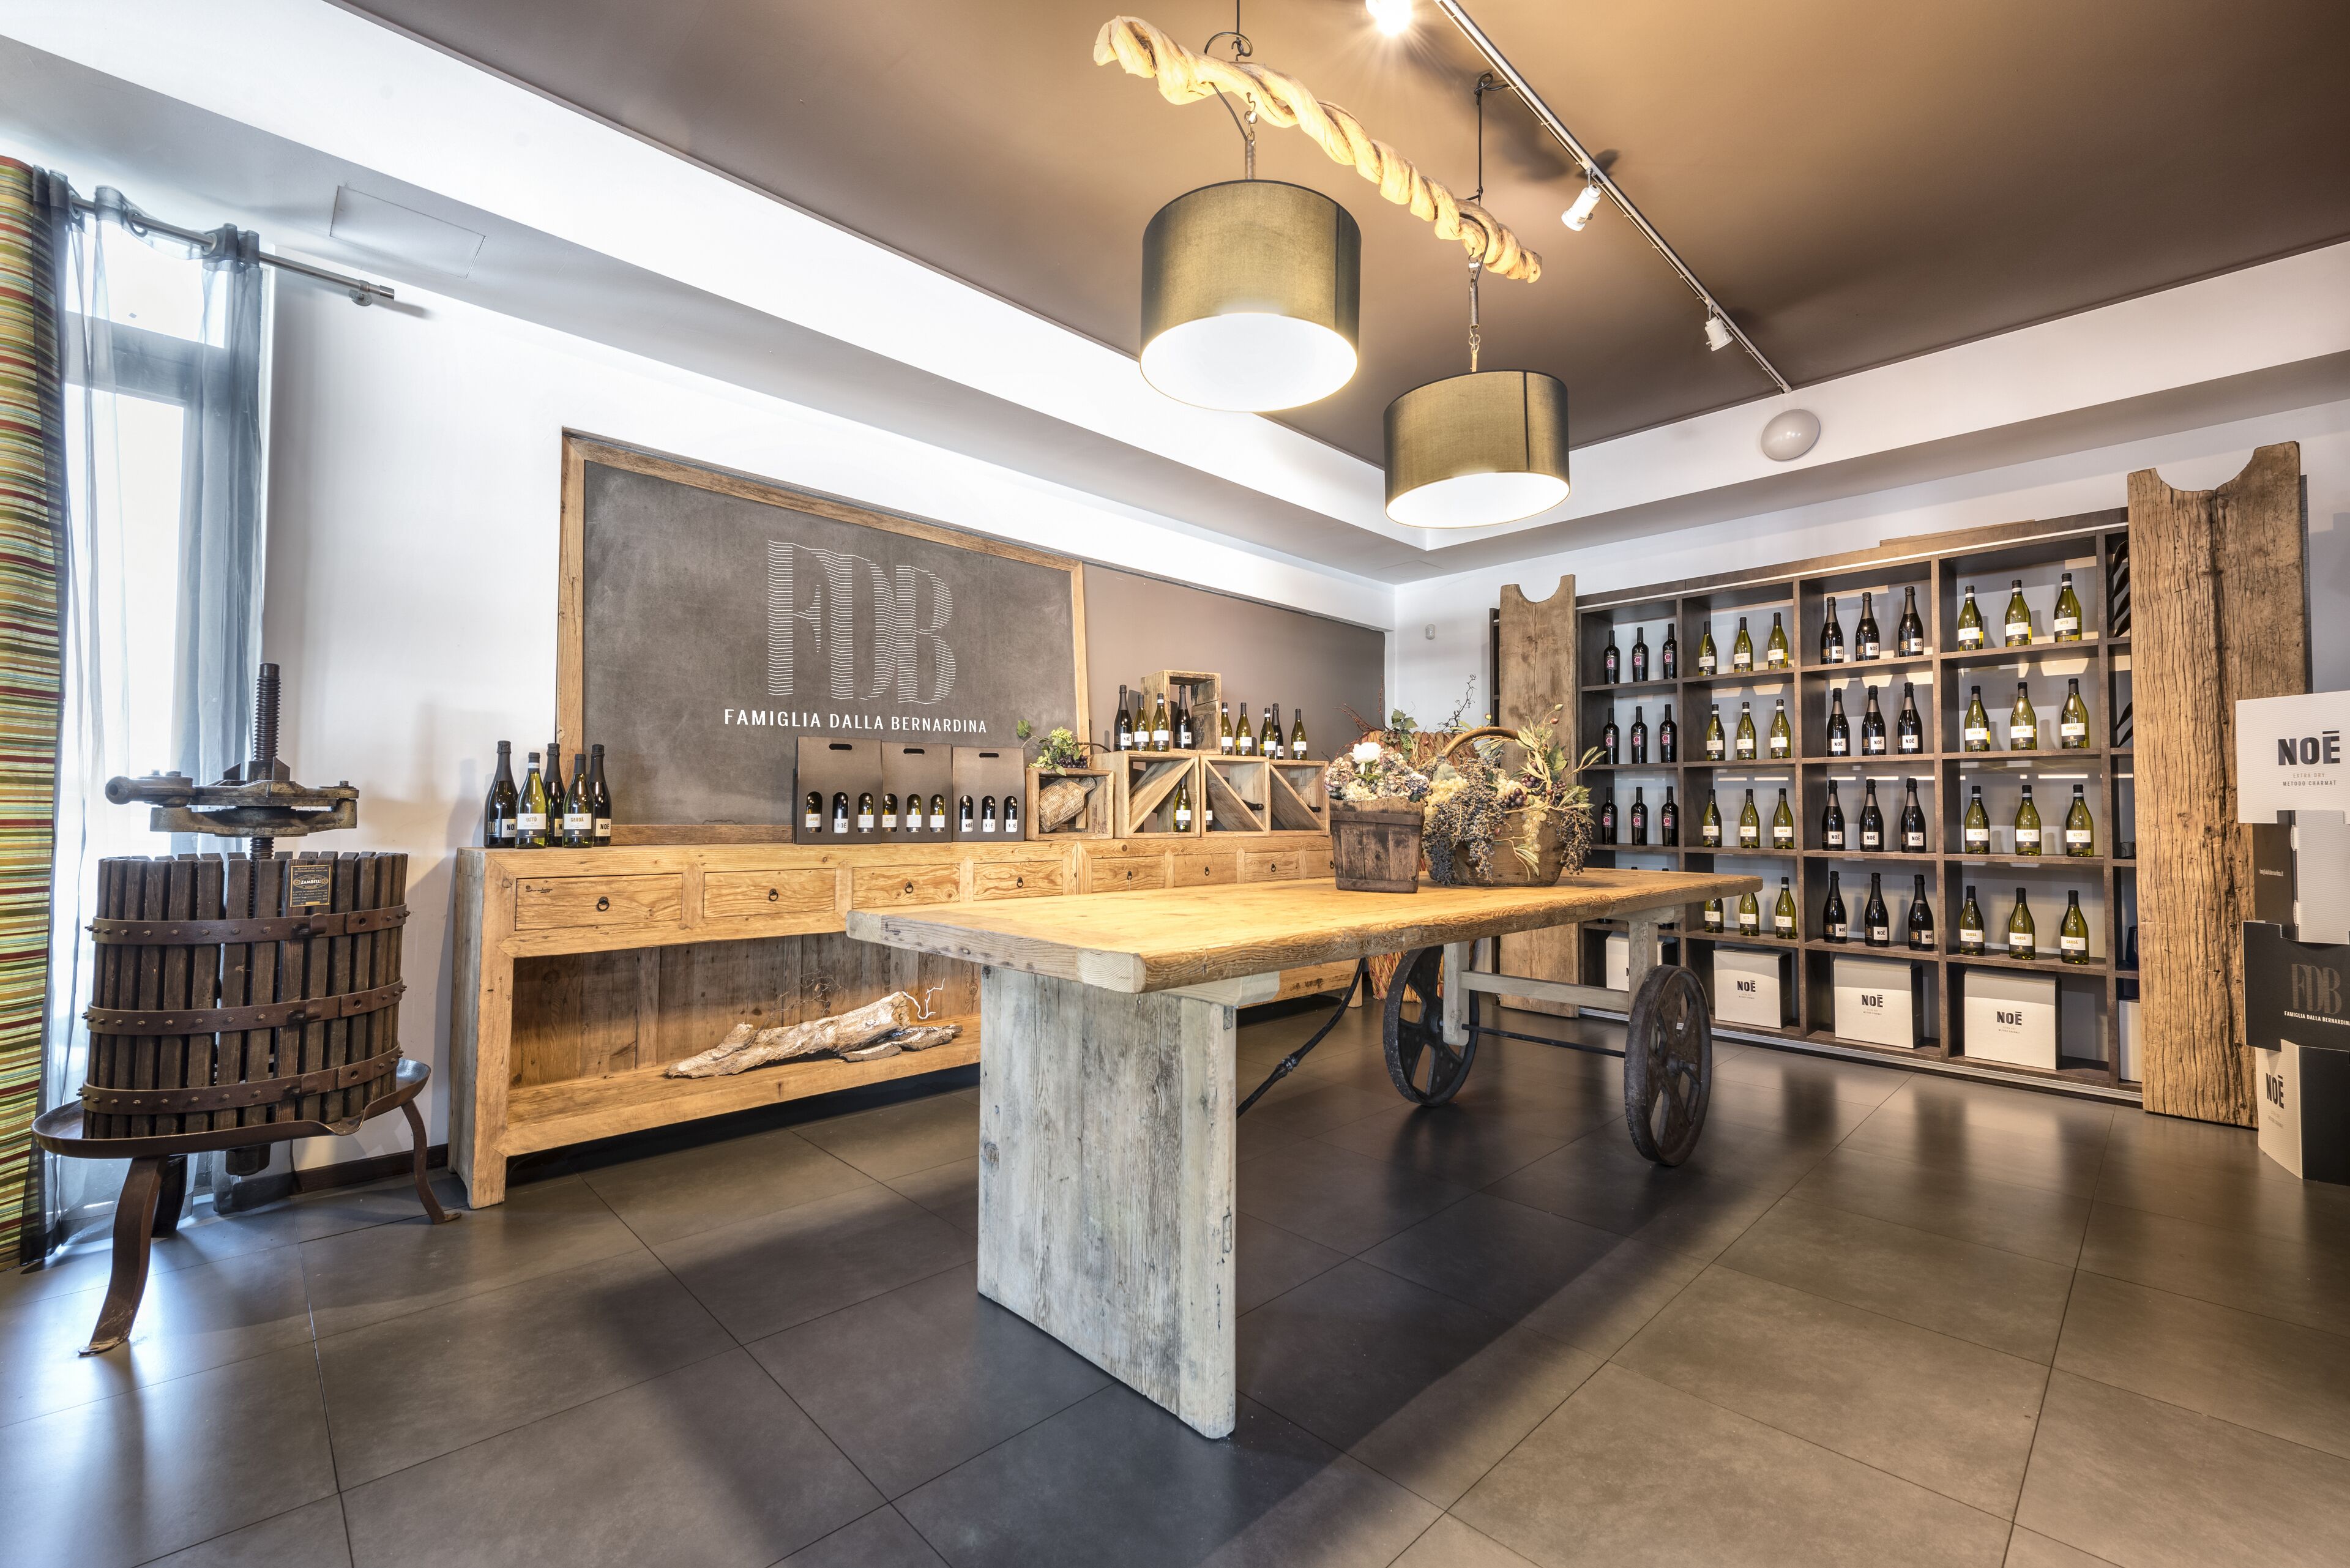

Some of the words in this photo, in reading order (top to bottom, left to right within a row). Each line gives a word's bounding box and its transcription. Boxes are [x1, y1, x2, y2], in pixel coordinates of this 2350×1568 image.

[768, 539, 956, 705] FDB
[725, 708, 821, 728] FAMIGLIA
[830, 714, 883, 730] DALLA
[892, 716, 987, 733] BERNARDINA
[2291, 963, 2342, 1014] FDB
[2284, 1010, 2305, 1019] FAMIGLIA
